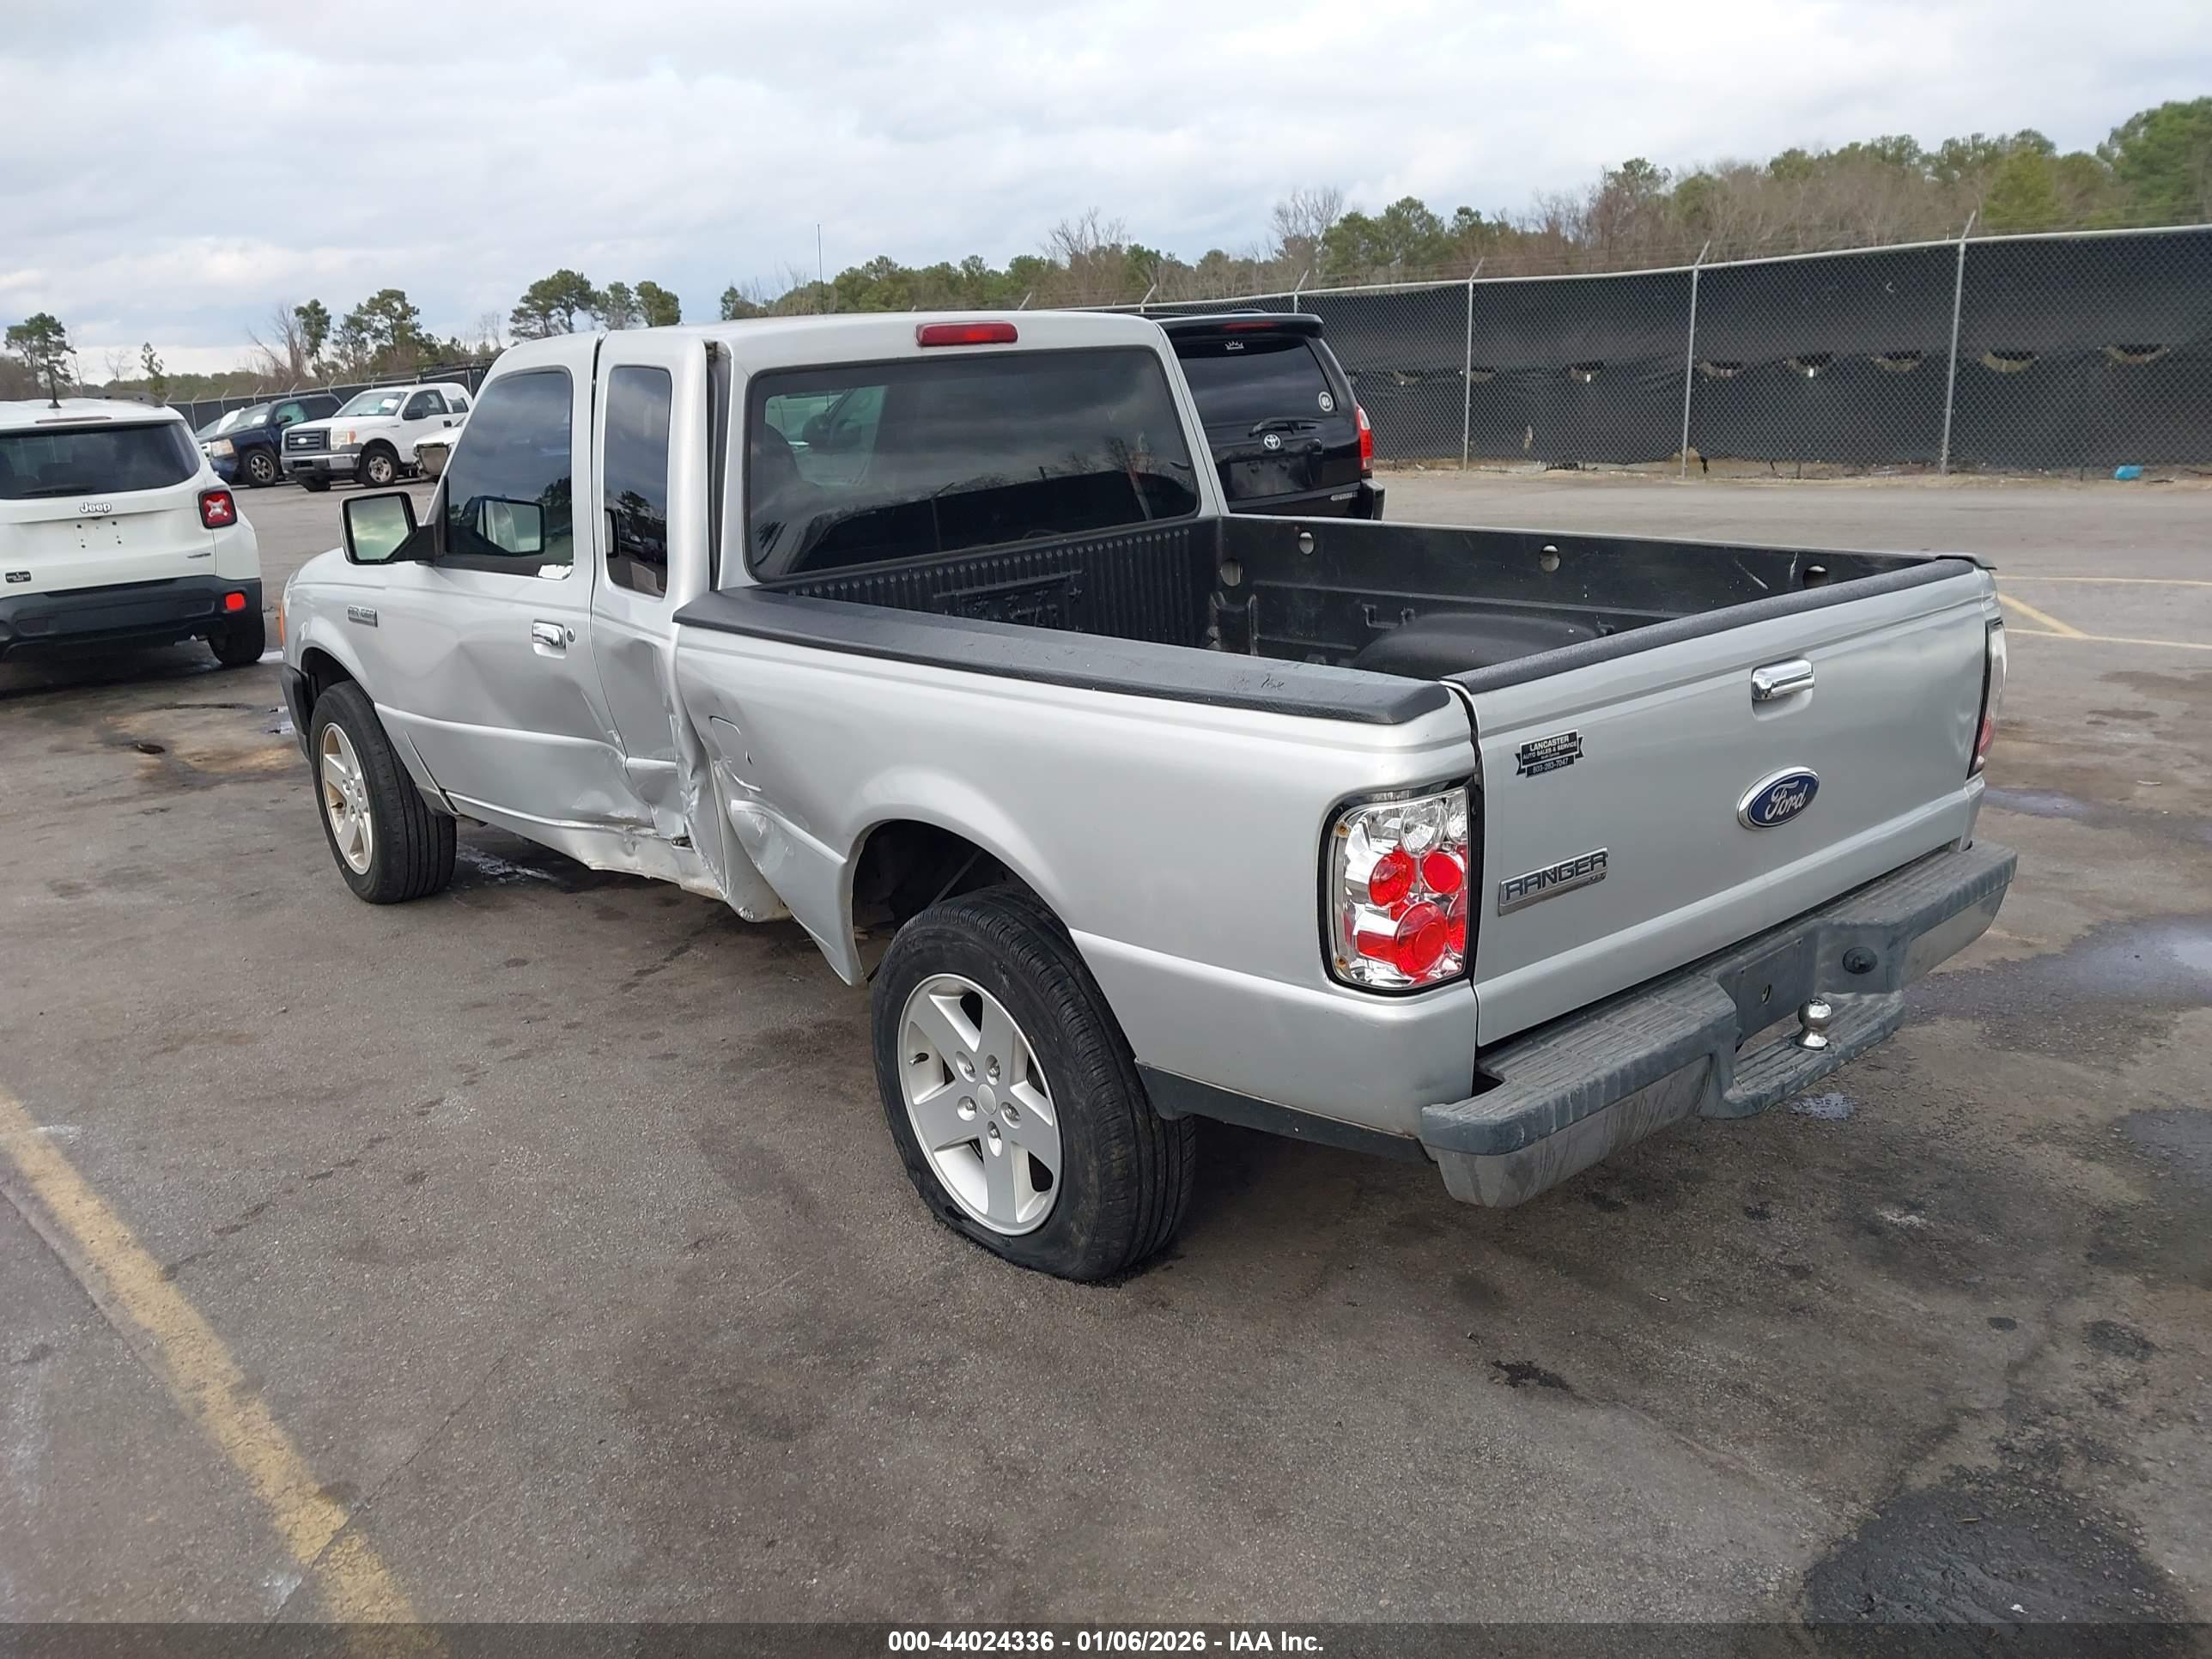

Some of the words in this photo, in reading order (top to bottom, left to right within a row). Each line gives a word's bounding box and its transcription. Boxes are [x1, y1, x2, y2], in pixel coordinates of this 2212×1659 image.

[80, 502, 112, 514] Jeep
[1522, 751, 1536, 760] AUTO
[1536, 747, 1553, 757] SALES
[1557, 740, 1577, 751] SERVICE
[1529, 734, 1570, 752] LANCASTER
[1765, 780, 1808, 820] Ford
[1505, 851, 1608, 901] RANGER
